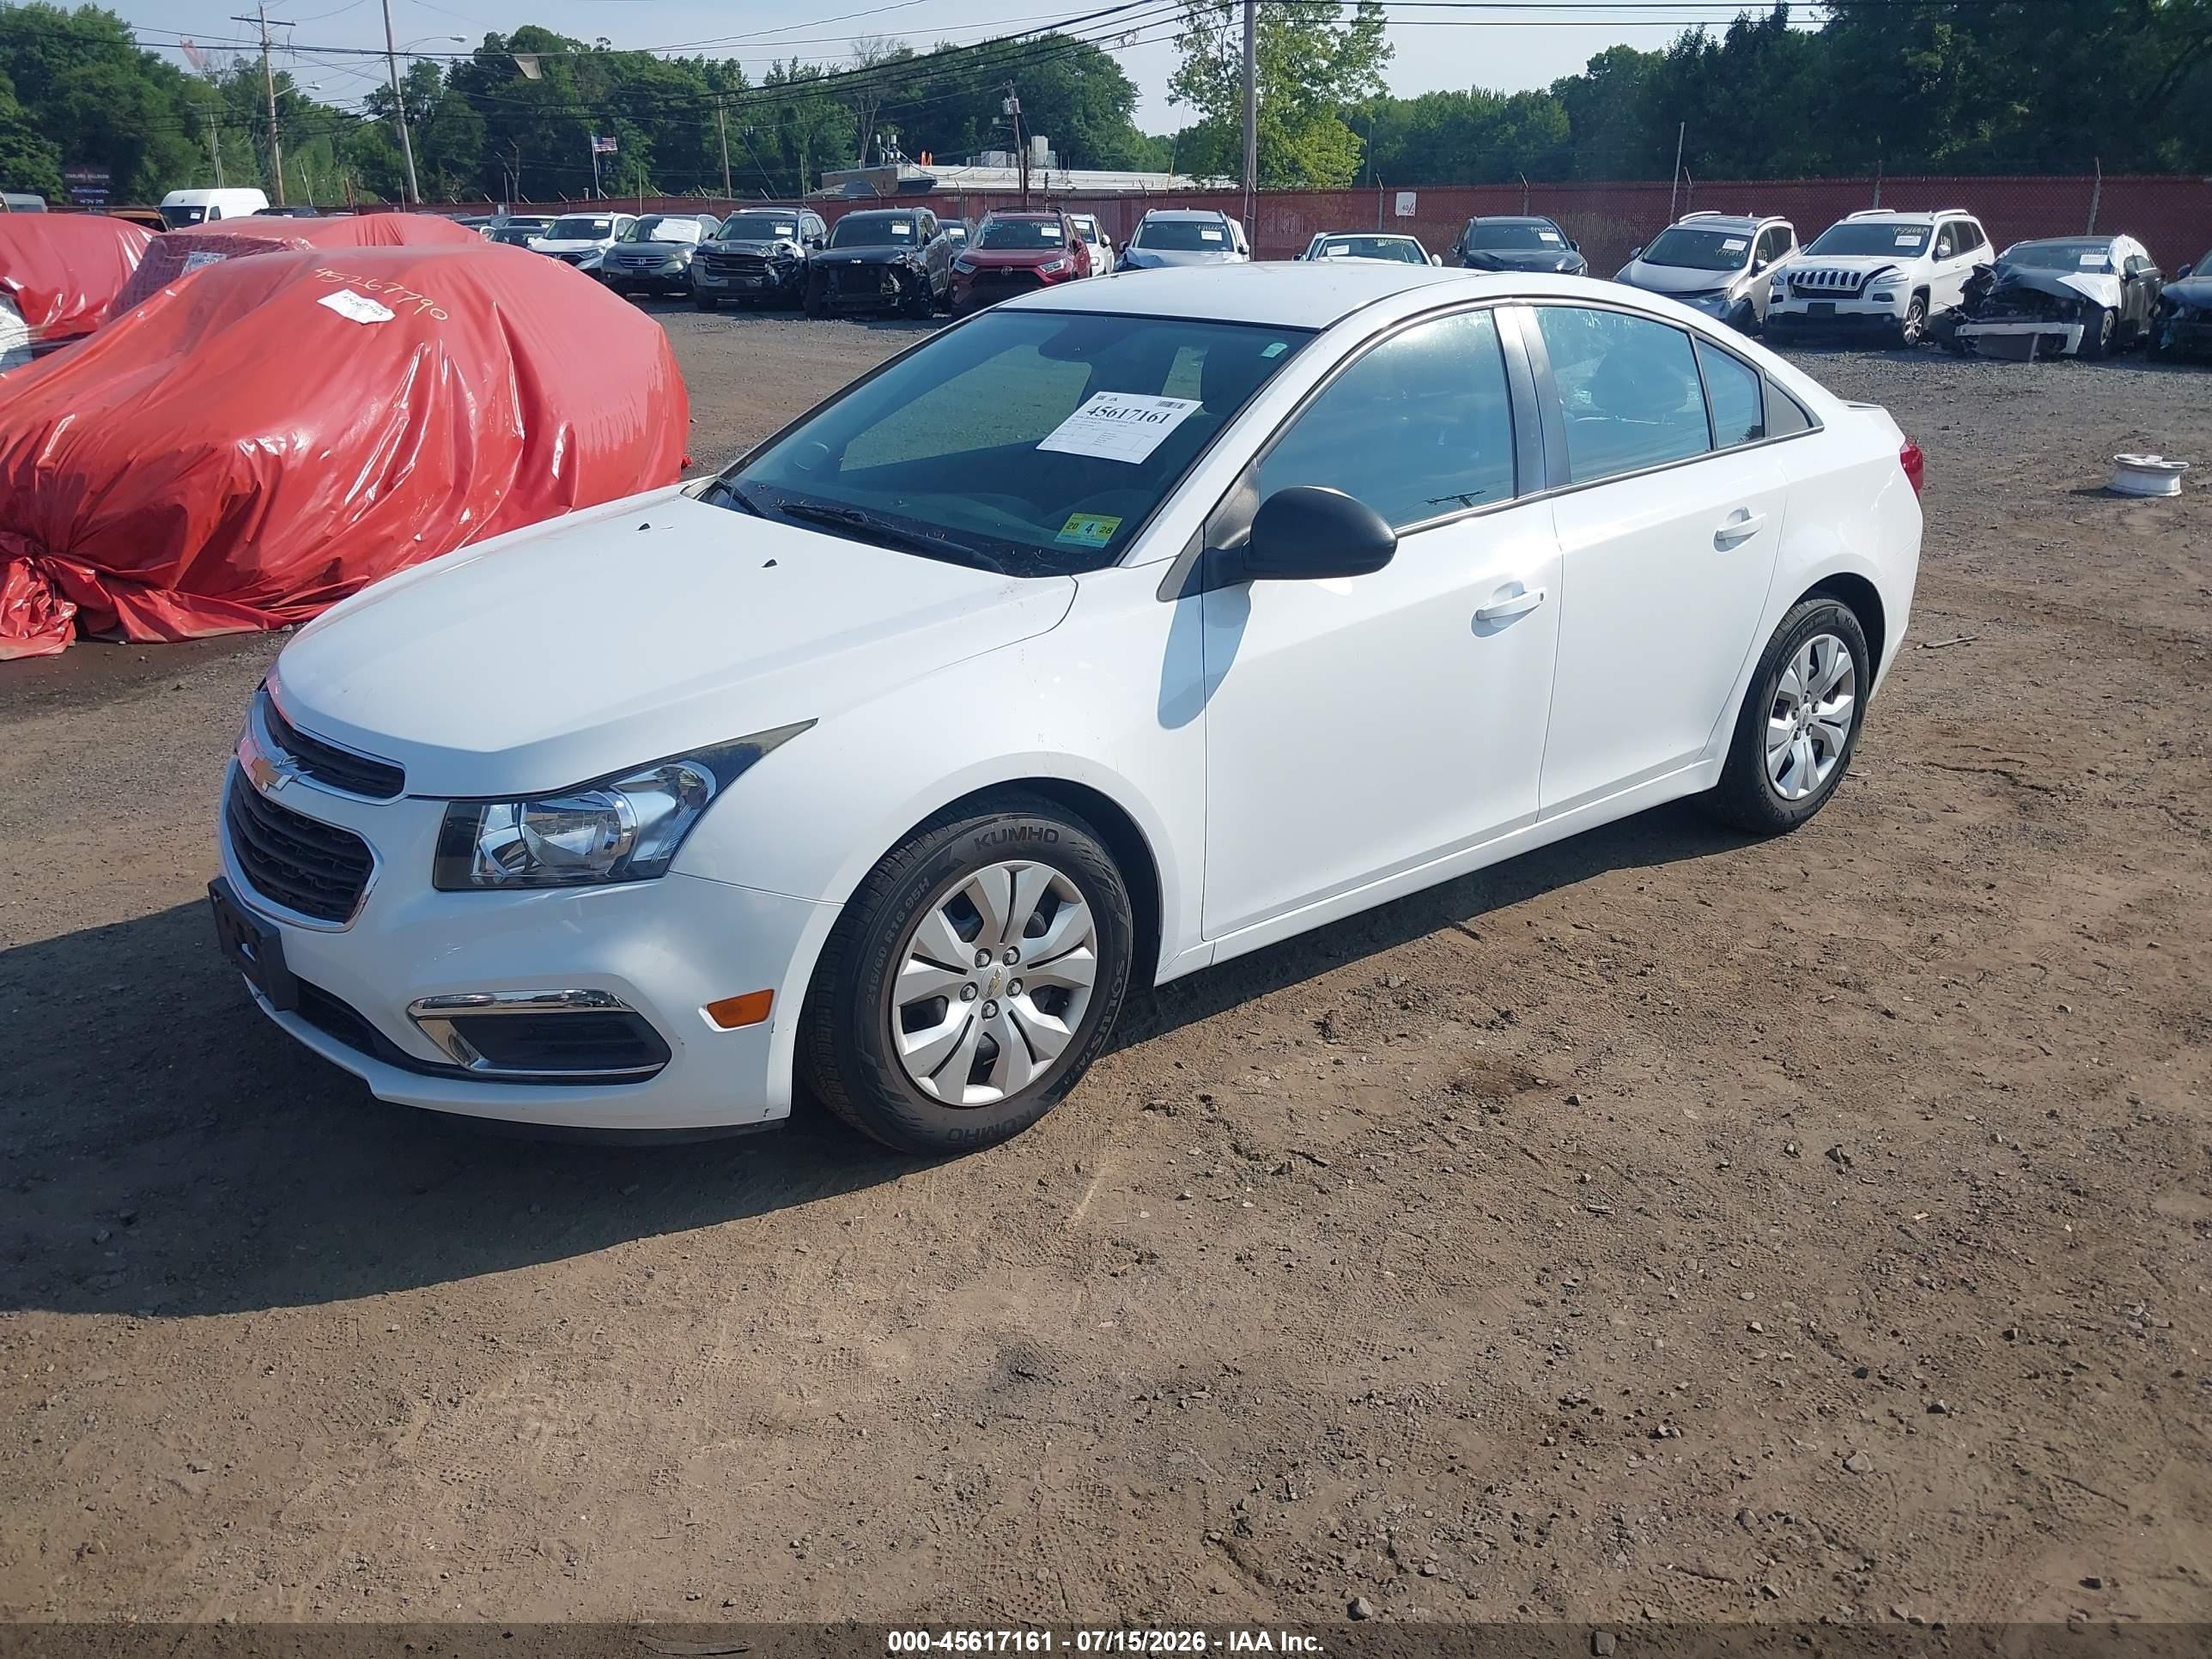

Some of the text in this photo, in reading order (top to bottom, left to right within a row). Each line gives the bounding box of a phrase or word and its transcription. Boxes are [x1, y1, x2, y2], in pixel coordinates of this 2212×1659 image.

[315, 268, 448, 320] 45267790
[1086, 404, 1173, 424] 45617161
[1085, 522, 1095, 533] 4
[974, 826, 1060, 852] KUMHO
[866, 877, 930, 1006] 215/60 R16 95H
[1090, 959, 1126, 1050] SOLUS
